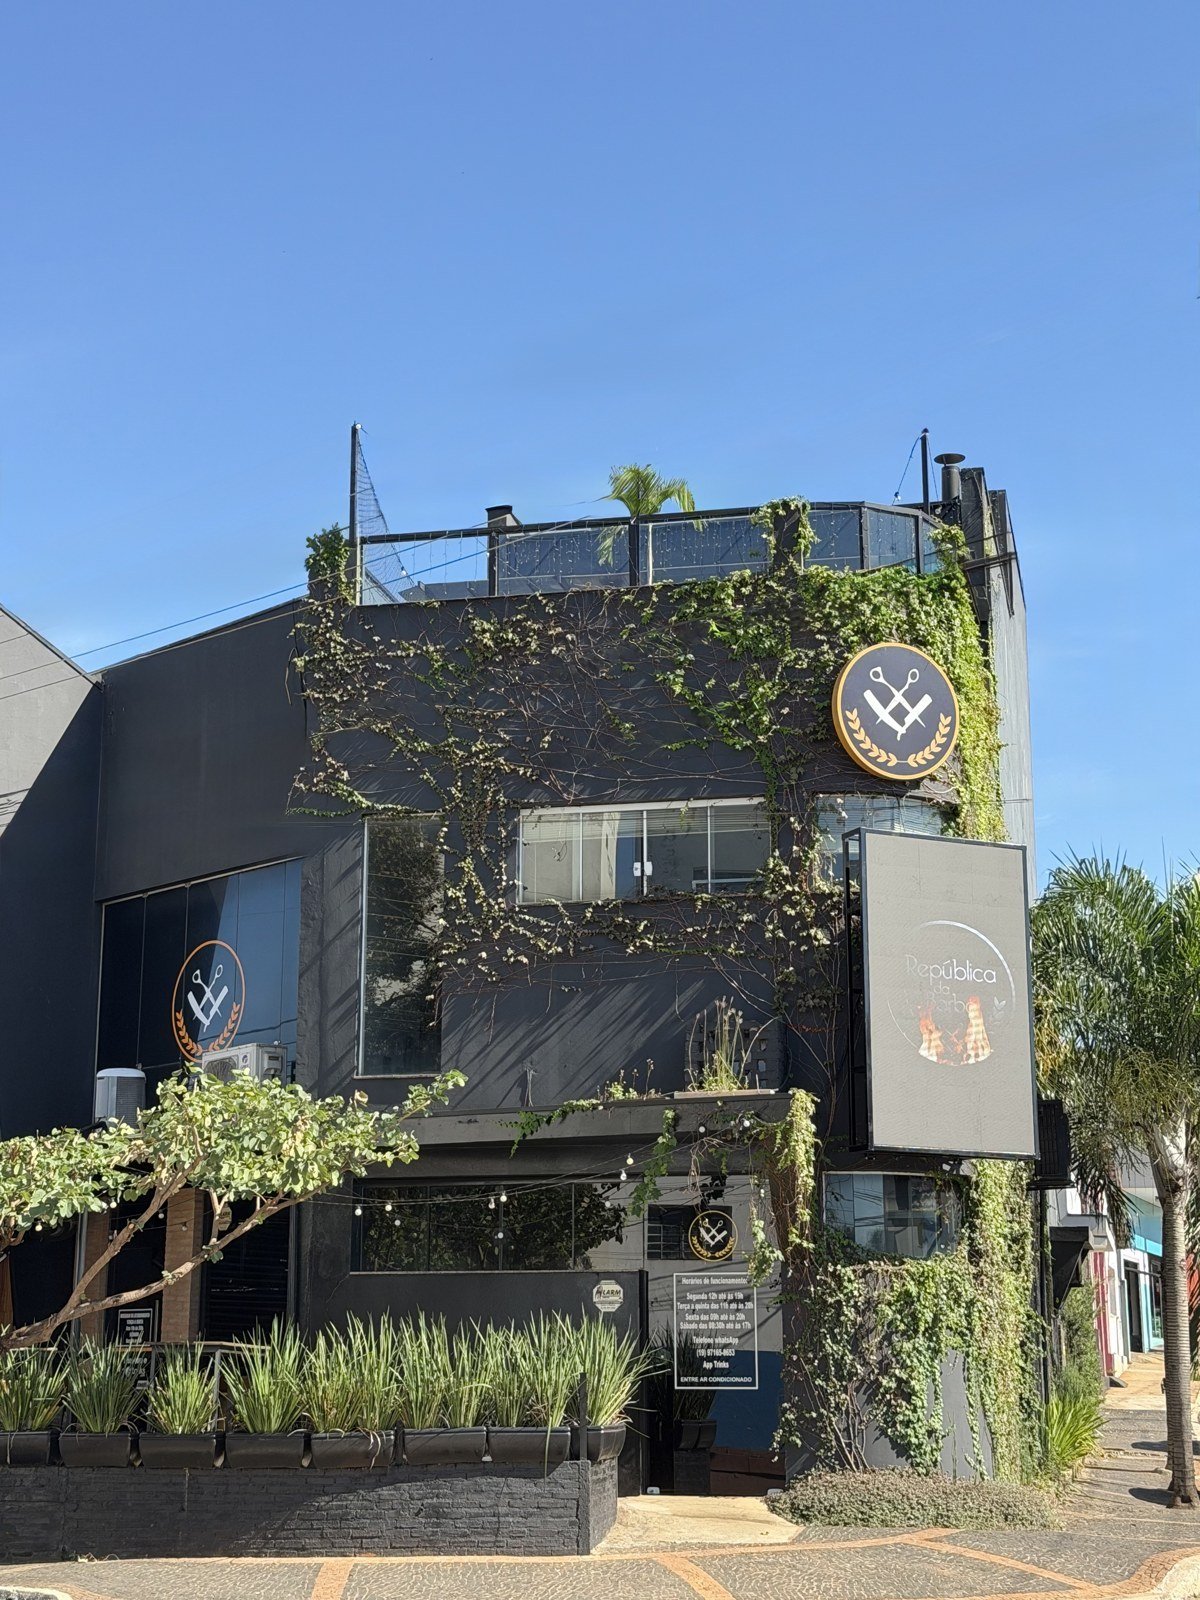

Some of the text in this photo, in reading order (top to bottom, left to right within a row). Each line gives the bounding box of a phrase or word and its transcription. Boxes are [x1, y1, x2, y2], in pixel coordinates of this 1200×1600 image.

[904, 954, 997, 986] República
[933, 980, 950, 995] da
[687, 1292, 708, 1301] Segunda
[708, 1292, 717, 1300] 12h
[718, 1292, 726, 1300] até
[677, 1302, 691, 1310] Terça
[695, 1302, 709, 1310] quinta
[693, 1336, 714, 1344] Telefone
[696, 1348, 706, 1358] (19)
[703, 1360, 729, 1370] App Trinks
